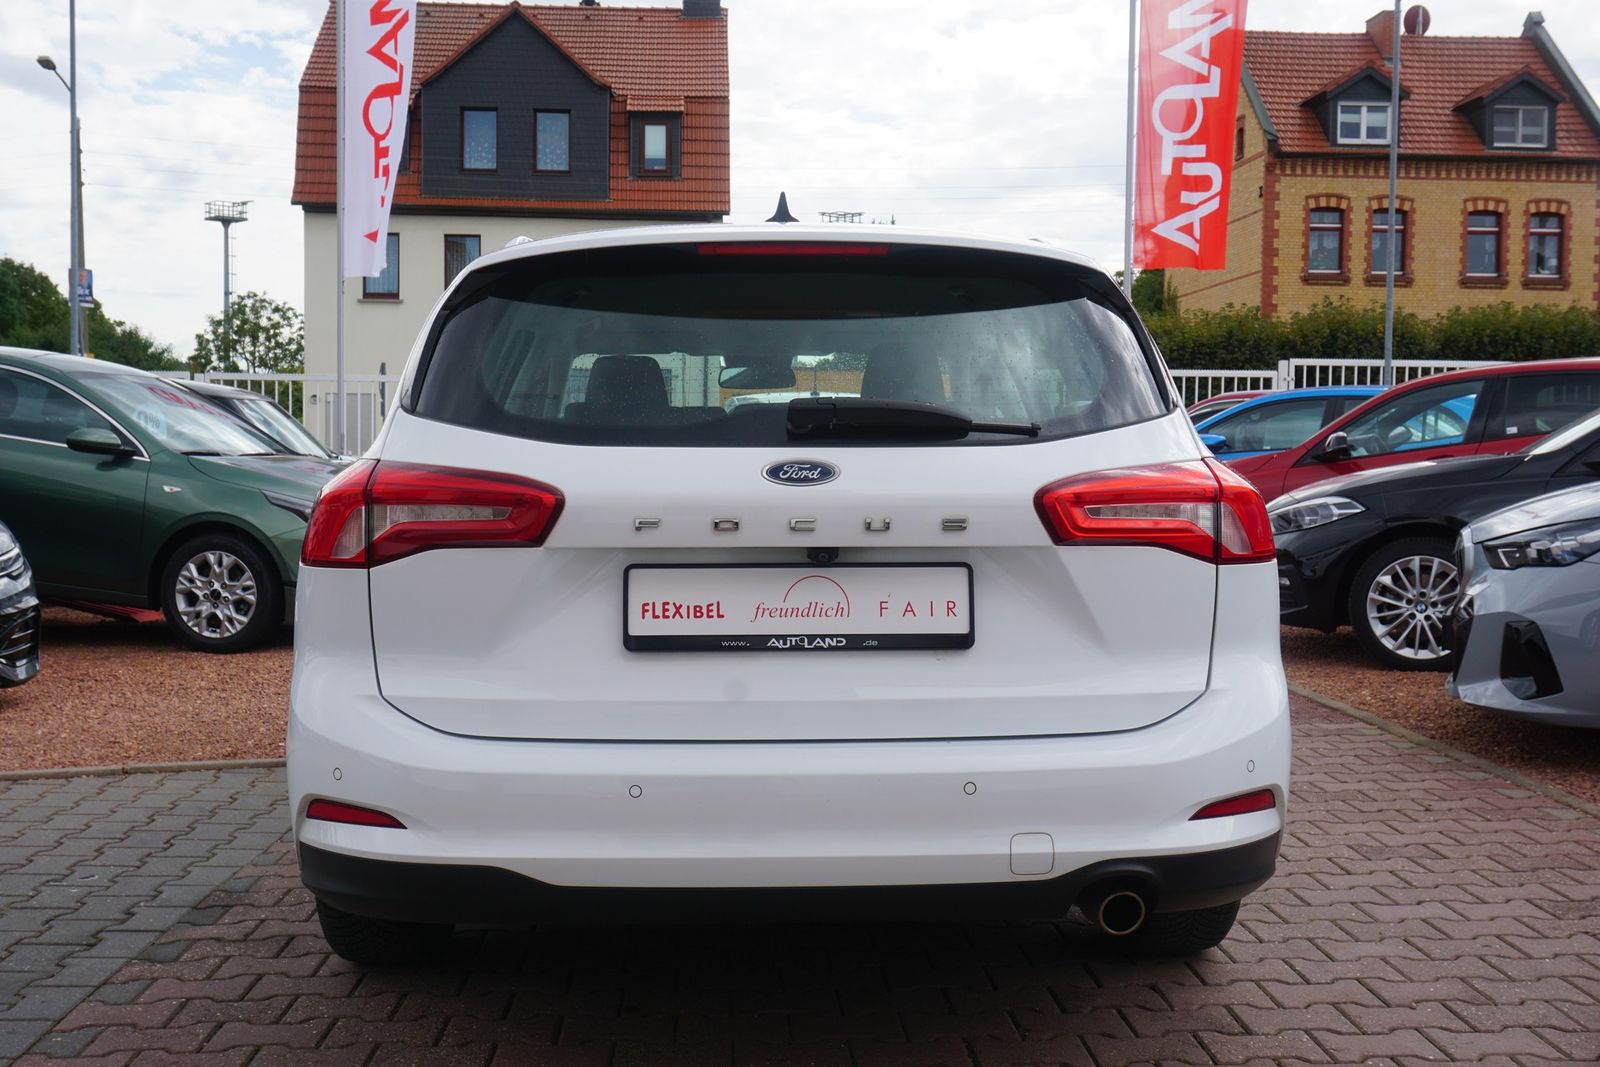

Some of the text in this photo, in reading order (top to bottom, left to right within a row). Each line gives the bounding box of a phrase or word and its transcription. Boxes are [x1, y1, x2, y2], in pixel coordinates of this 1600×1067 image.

[779, 463, 821, 479] Ford
[634, 518, 968, 531] FOCUS
[750, 600, 846, 623] freundlich
[879, 600, 957, 617] FAIR
[767, 635, 847, 649] AUTOLAND
